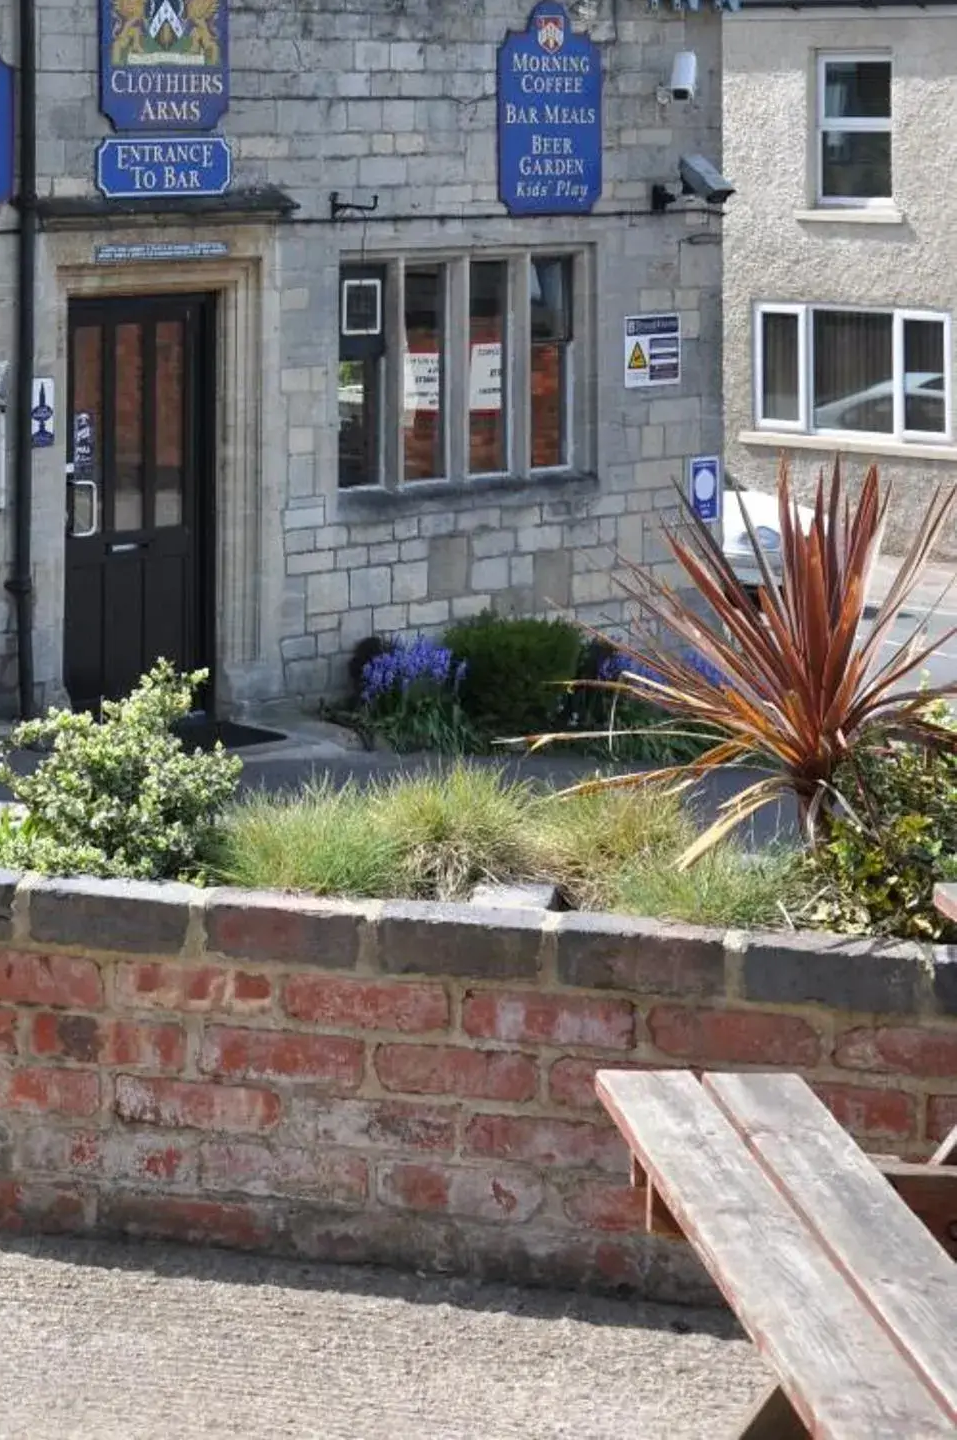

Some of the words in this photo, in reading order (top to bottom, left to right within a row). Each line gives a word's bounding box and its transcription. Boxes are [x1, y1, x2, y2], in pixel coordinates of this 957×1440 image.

[512, 54, 590, 73] MORNING
[110, 69, 224, 96] CLOTHIERS
[520, 74, 584, 94] COFFEE
[139, 98, 202, 122] ARMS
[505, 103, 540, 125] BAR
[544, 104, 596, 124] MEALS
[116, 144, 214, 168] ENTRANCE
[531, 134, 573, 155] BEER
[518, 155, 584, 176] GARDEN
[129, 166, 158, 190] TO
[163, 166, 201, 190] BAR
[555, 179, 589, 203] Play
